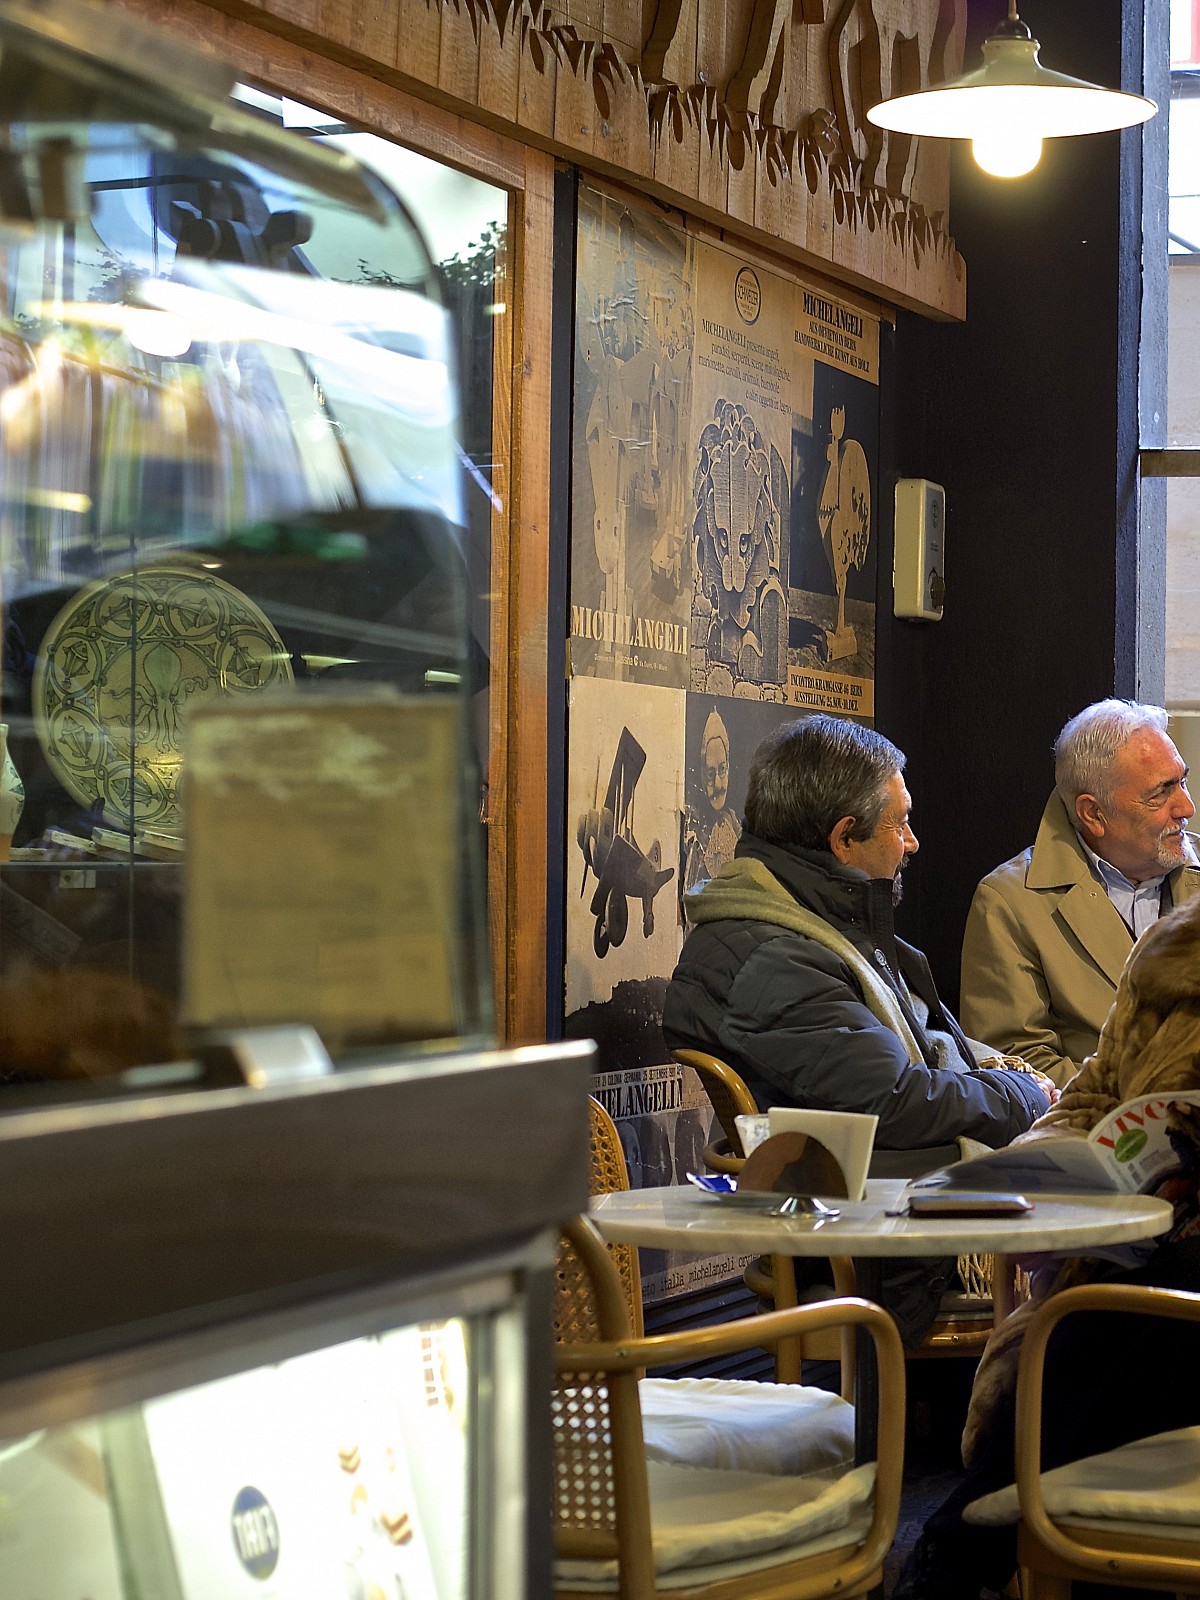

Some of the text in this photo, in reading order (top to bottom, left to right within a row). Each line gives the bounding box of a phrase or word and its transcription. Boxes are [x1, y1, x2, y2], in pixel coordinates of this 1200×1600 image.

[701, 318, 746, 348] MICHELANGELI
[802, 292, 864, 339] MICHELANGELI
[834, 346, 850, 365] KUNST
[571, 605, 688, 655] MICHELANGELI
[794, 690, 826, 707] AUSSTELLUNG
[591, 1079, 675, 1119] HELANGELI
[660, 1272, 685, 1292] italia
[688, 1257, 735, 1284] michelangeli
